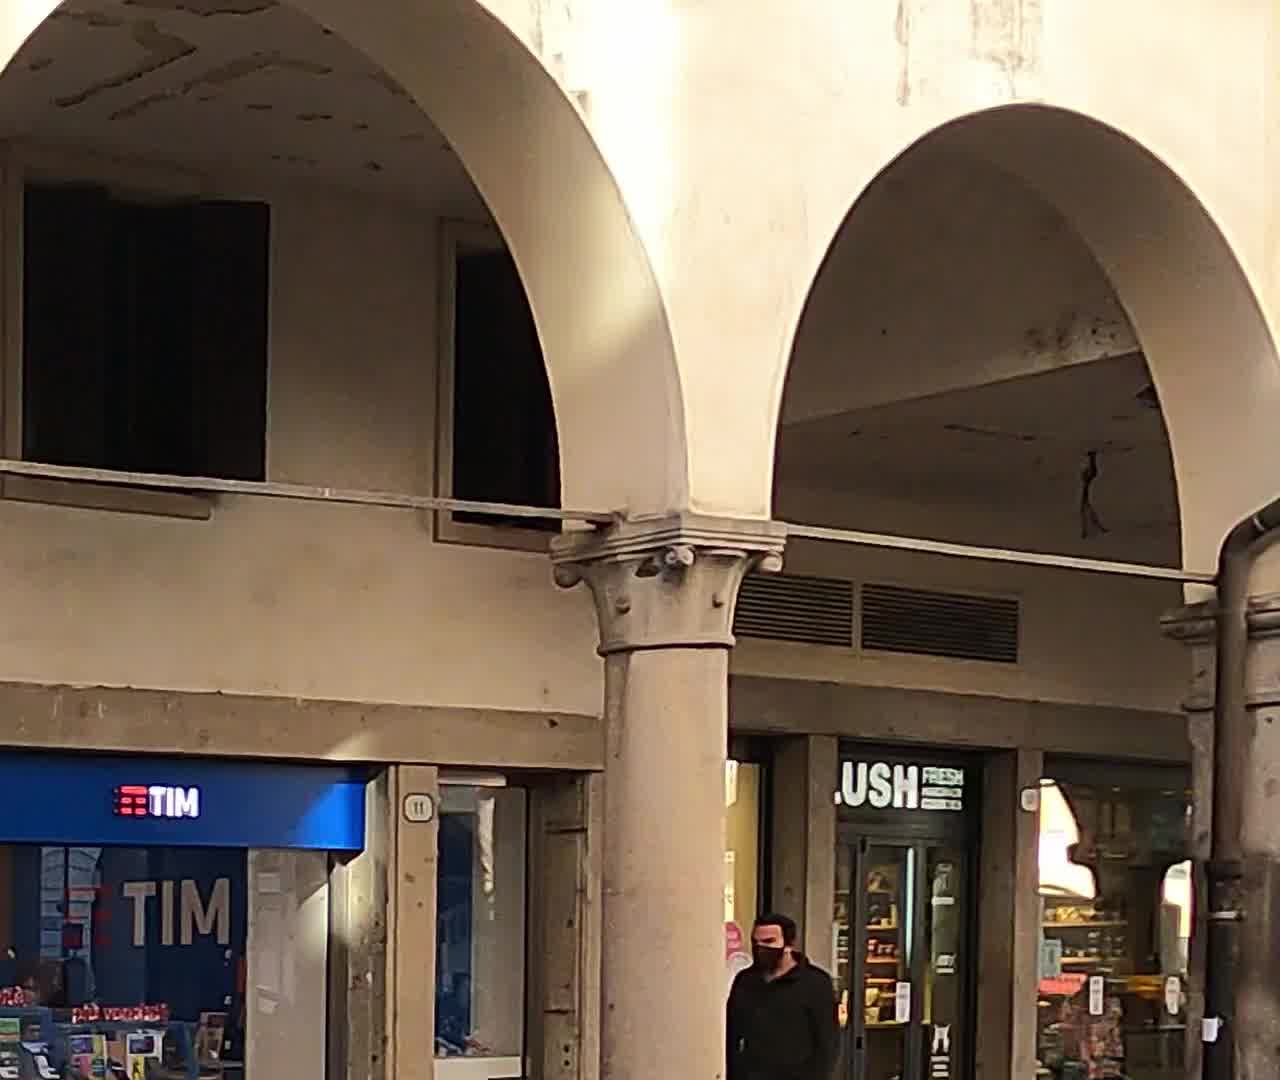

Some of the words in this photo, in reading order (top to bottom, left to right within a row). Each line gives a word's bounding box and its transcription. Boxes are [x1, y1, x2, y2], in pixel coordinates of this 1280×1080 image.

[149, 786, 199, 817] TIM
[834, 761, 919, 809] USH
[124, 878, 230, 946] TIM
